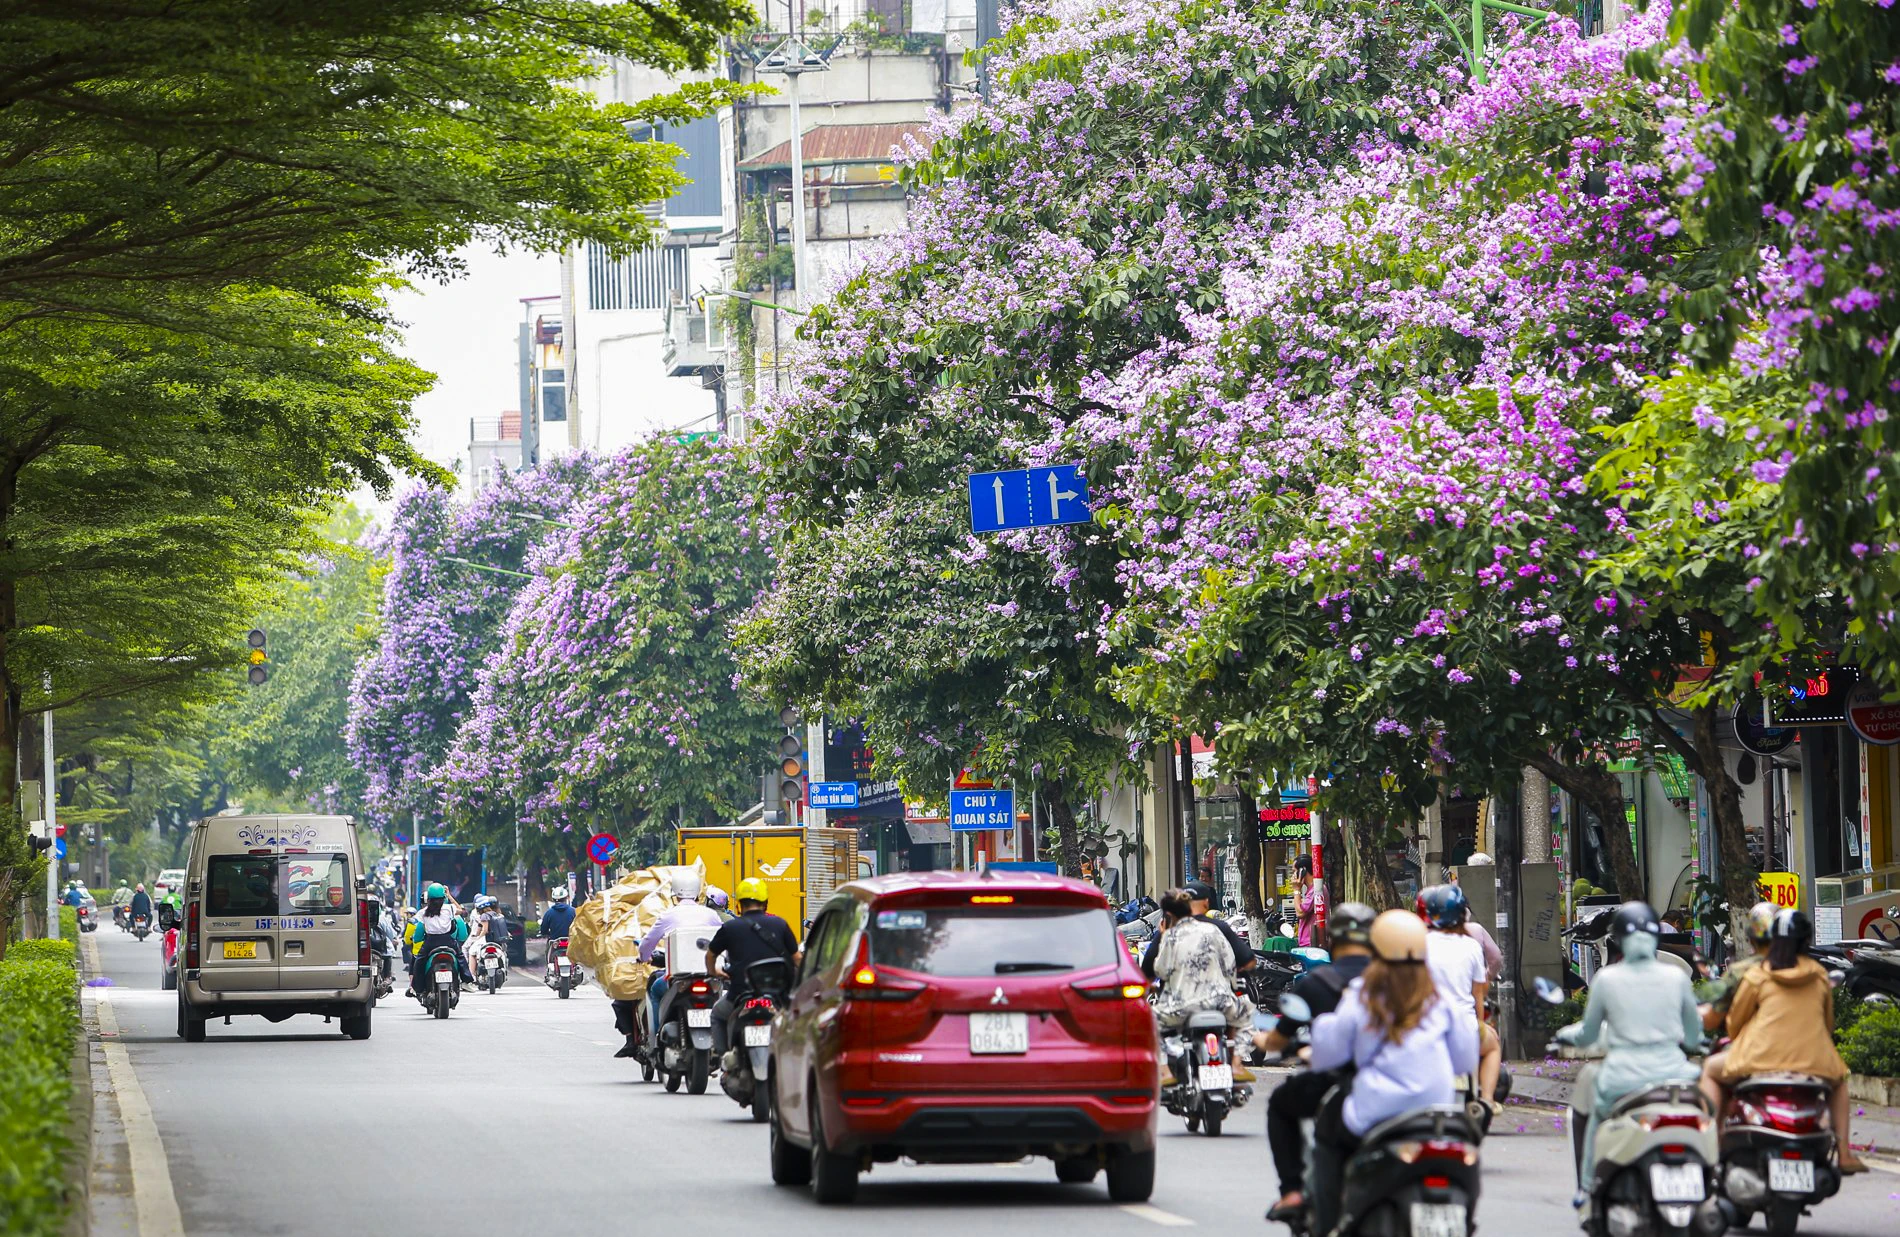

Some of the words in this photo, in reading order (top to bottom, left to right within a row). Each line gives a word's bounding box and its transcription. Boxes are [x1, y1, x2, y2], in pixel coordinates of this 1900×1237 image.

[828, 784, 844, 792] PHỐ
[964, 793, 987, 808] CHÚ
[990, 793, 997, 807] Ý
[954, 813, 985, 825] QUAN
[988, 810, 1009, 824] SÁT
[1266, 821, 1281, 837] SỐ
[1777, 877, 1797, 907] BÒ
[281, 918, 314, 929] 014.28
[233, 942, 247, 950] 15F
[227, 950, 253, 958] 014.28
[985, 1013, 1013, 1031] 28A
[973, 1033, 1025, 1050] 084.31
